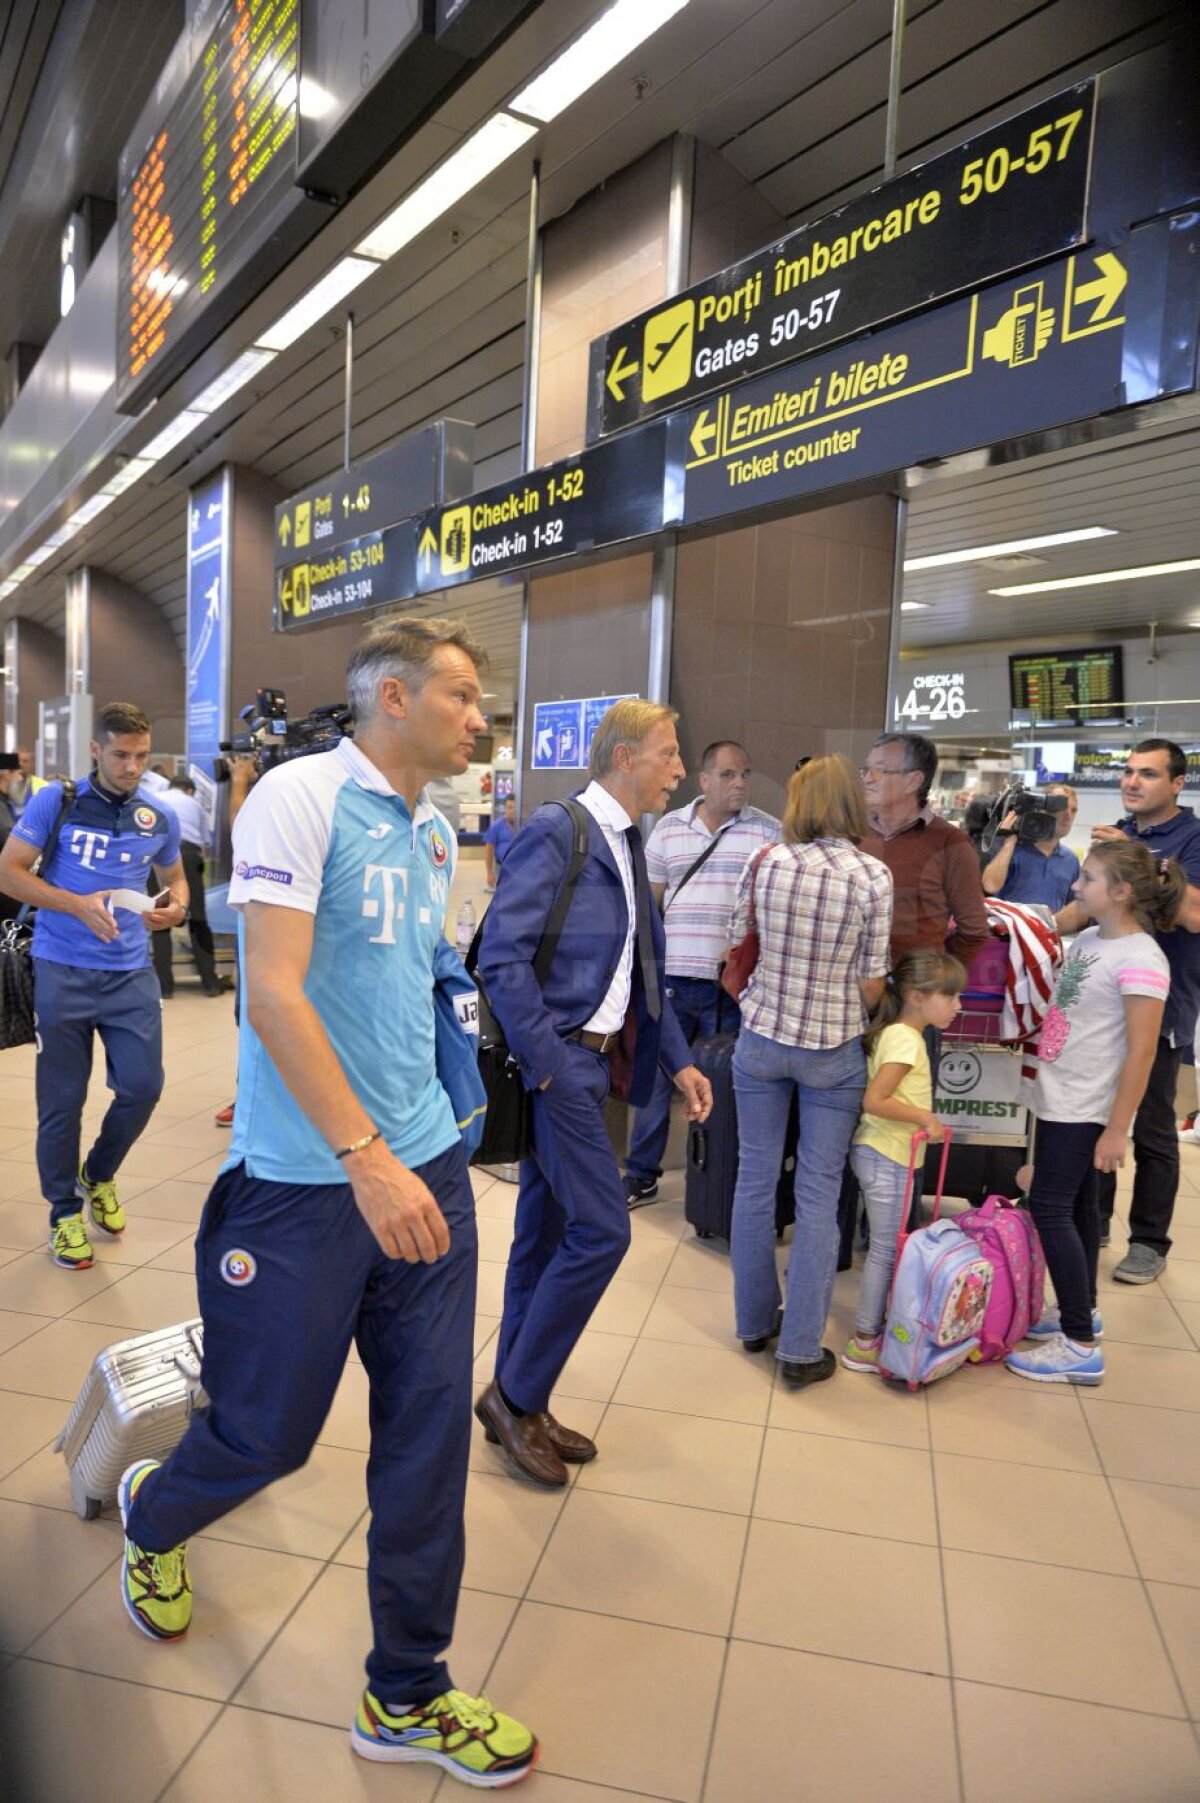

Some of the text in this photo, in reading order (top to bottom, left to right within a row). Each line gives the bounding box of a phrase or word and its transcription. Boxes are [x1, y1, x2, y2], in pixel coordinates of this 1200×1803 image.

[698, 108, 1083, 329] Porți îmbarcare 50-57
[694, 289, 841, 378] Gates 50-57
[1013, 318, 1026, 362] TICKET
[731, 350, 909, 442] Emiteri bilete
[726, 425, 861, 487] Ticket counter
[472, 468, 584, 532] Check-in 1-52
[310, 542, 384, 584] Check-in 53-104
[471, 518, 564, 567] Check-in 1-52
[311, 578, 373, 612] Check-in 53-104
[913, 672, 964, 689] CHECK-IN
[934, 1098, 1020, 1118] MPREST
